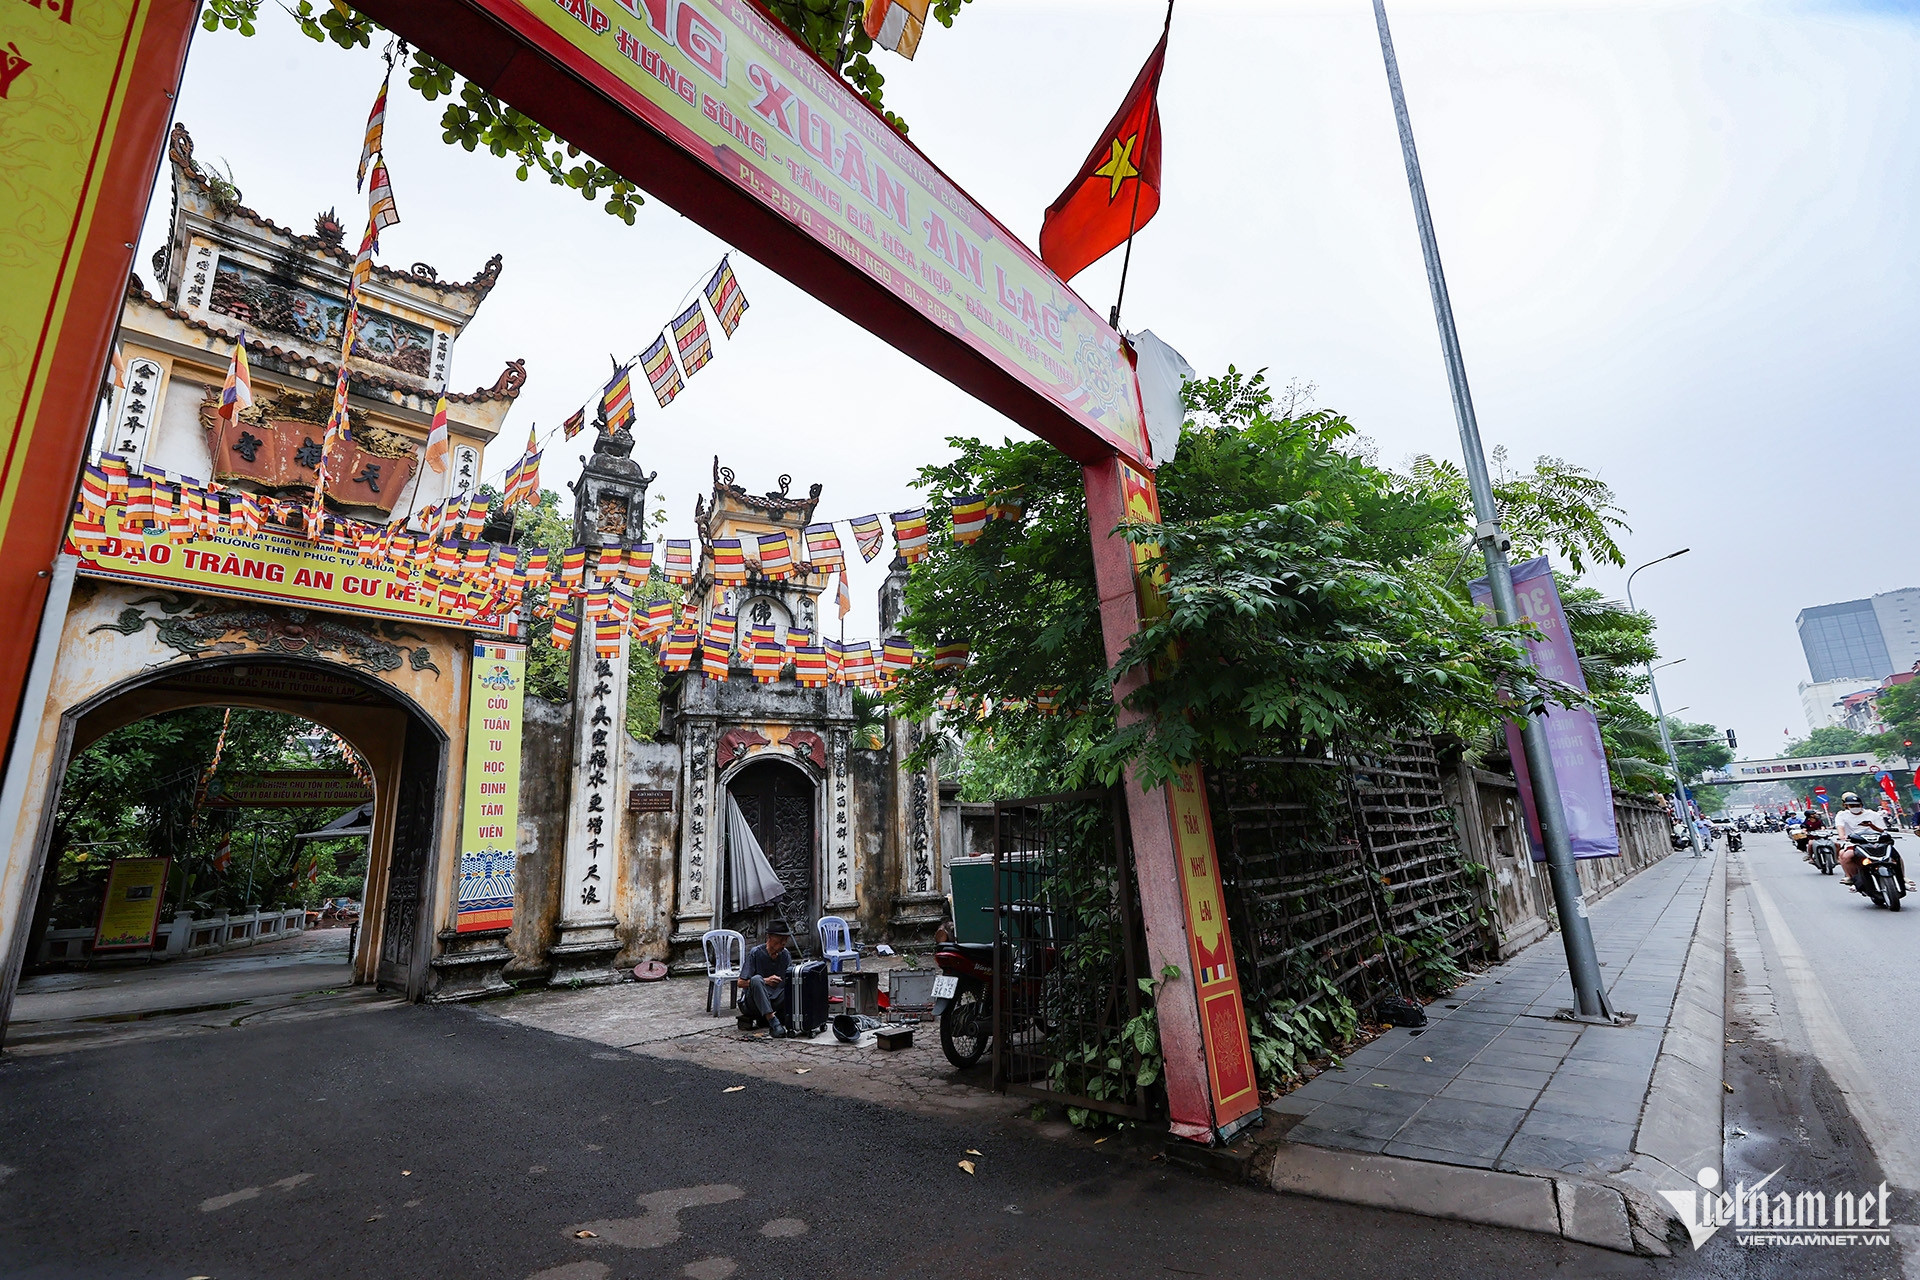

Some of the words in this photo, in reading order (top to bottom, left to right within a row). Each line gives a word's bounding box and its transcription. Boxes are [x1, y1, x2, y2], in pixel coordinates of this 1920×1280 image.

[615, 26, 695, 106] HƯNG
[702, 93, 766, 159] SÙNG
[786, 157, 841, 215] TĂNG
[845, 202, 877, 243] GIÀ
[746, 61, 911, 235] XUÂN
[922, 206, 986, 292] AN
[994, 260, 1064, 353] LẠC
[739, 163, 765, 195] PL:
[771, 186, 812, 226] 2570
[827, 224, 861, 261] BÍNH
[927, 300, 955, 328] 2026
[271, 535, 291, 545] GIÁO
[213, 535, 260, 550] RƯỜNG
[264, 544, 300, 557] THIÊN
[303, 551, 336, 563] PHÚC
[339, 557, 355, 568] TỰ
[182, 550, 286, 583] TRÀNG
[293, 568, 333, 591] AN
[342, 575, 382, 597] CƯ
[487, 694, 508, 710] CỬU
[489, 740, 502, 751] TU
[483, 761, 505, 775] HỌC
[480, 783, 506, 796] ĐỊNH
[481, 802, 503, 816] TÂM
[479, 824, 503, 838] VIÊN
